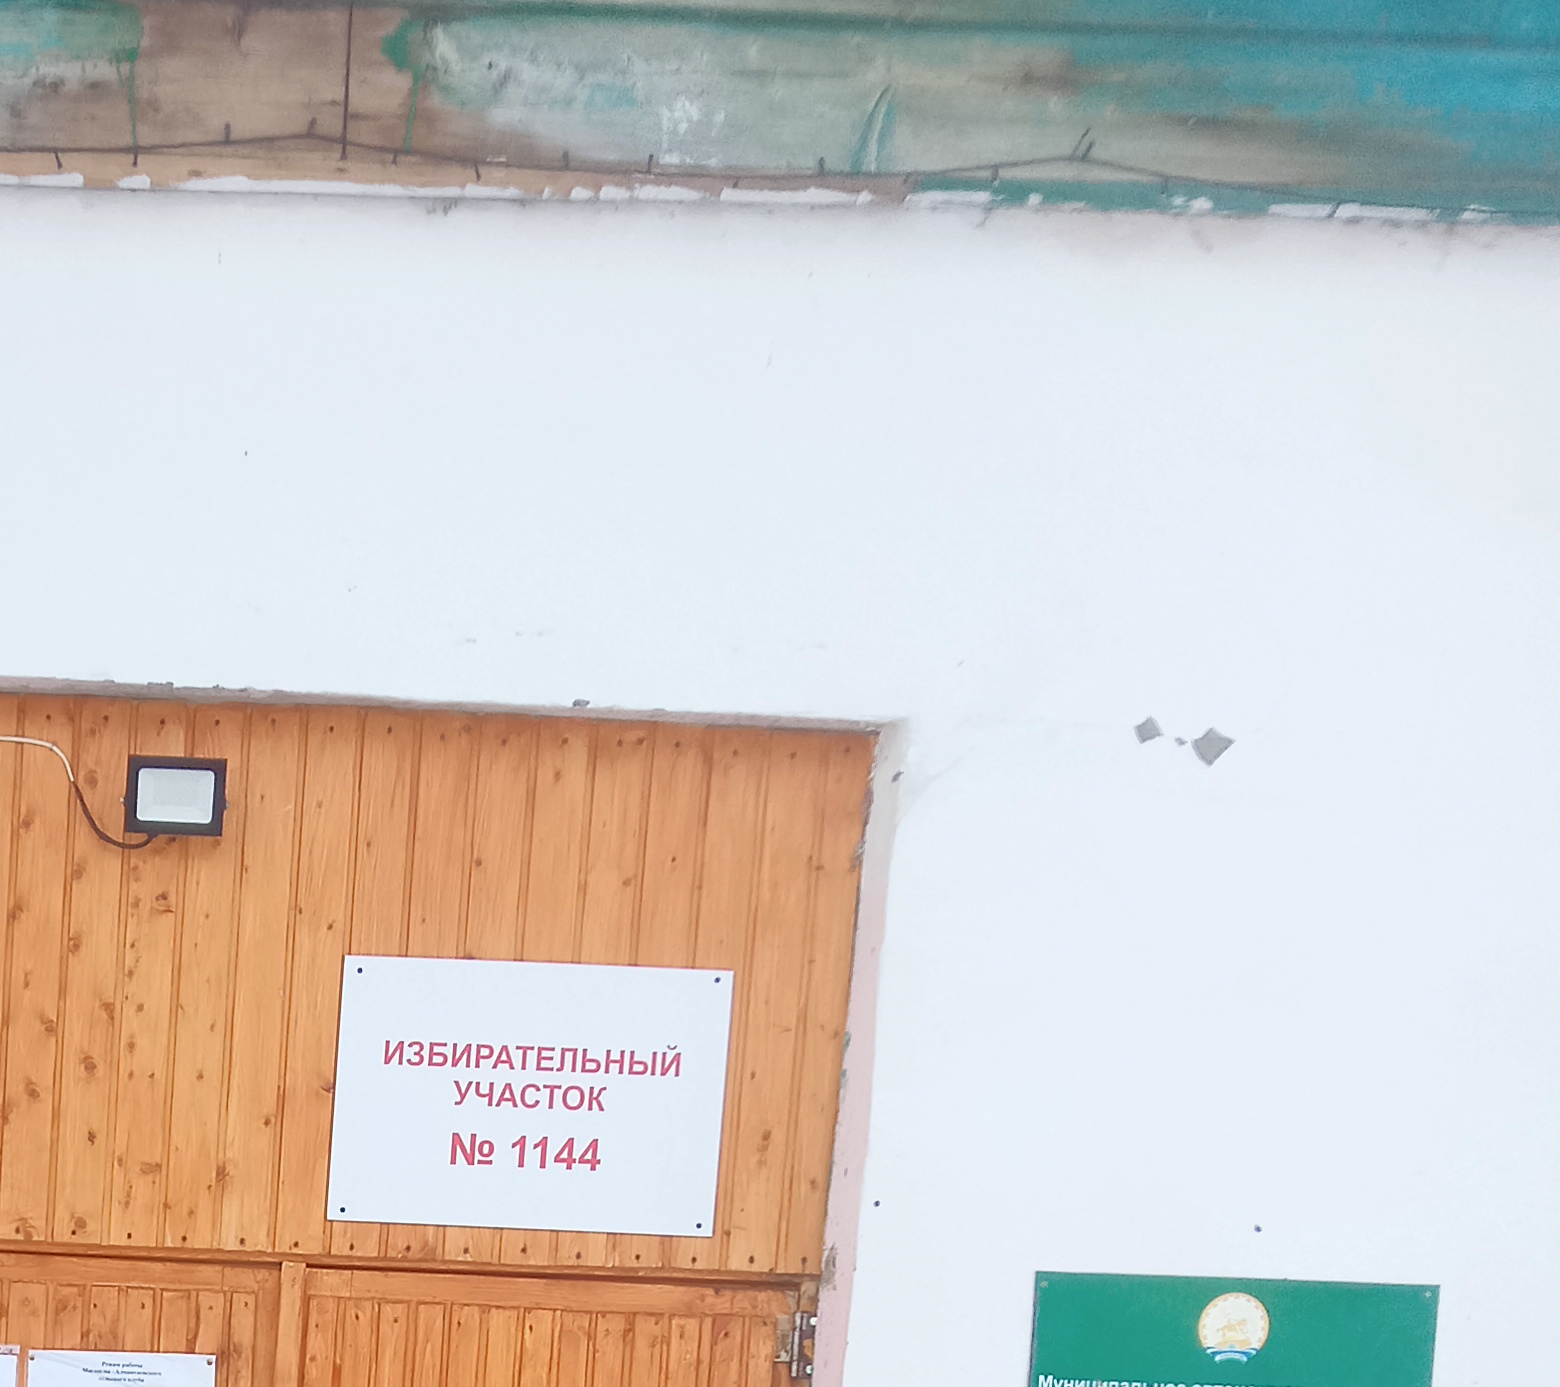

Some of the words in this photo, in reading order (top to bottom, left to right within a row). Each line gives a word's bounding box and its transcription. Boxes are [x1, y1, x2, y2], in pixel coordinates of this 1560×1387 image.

[383, 1039, 683, 1078] ИЗБИРАТЕЛЬНЫЙ
[453, 1080, 607, 1112] УЧАСТОК
[449, 1132, 495, 1167] №
[511, 1134, 601, 1172] 1144
